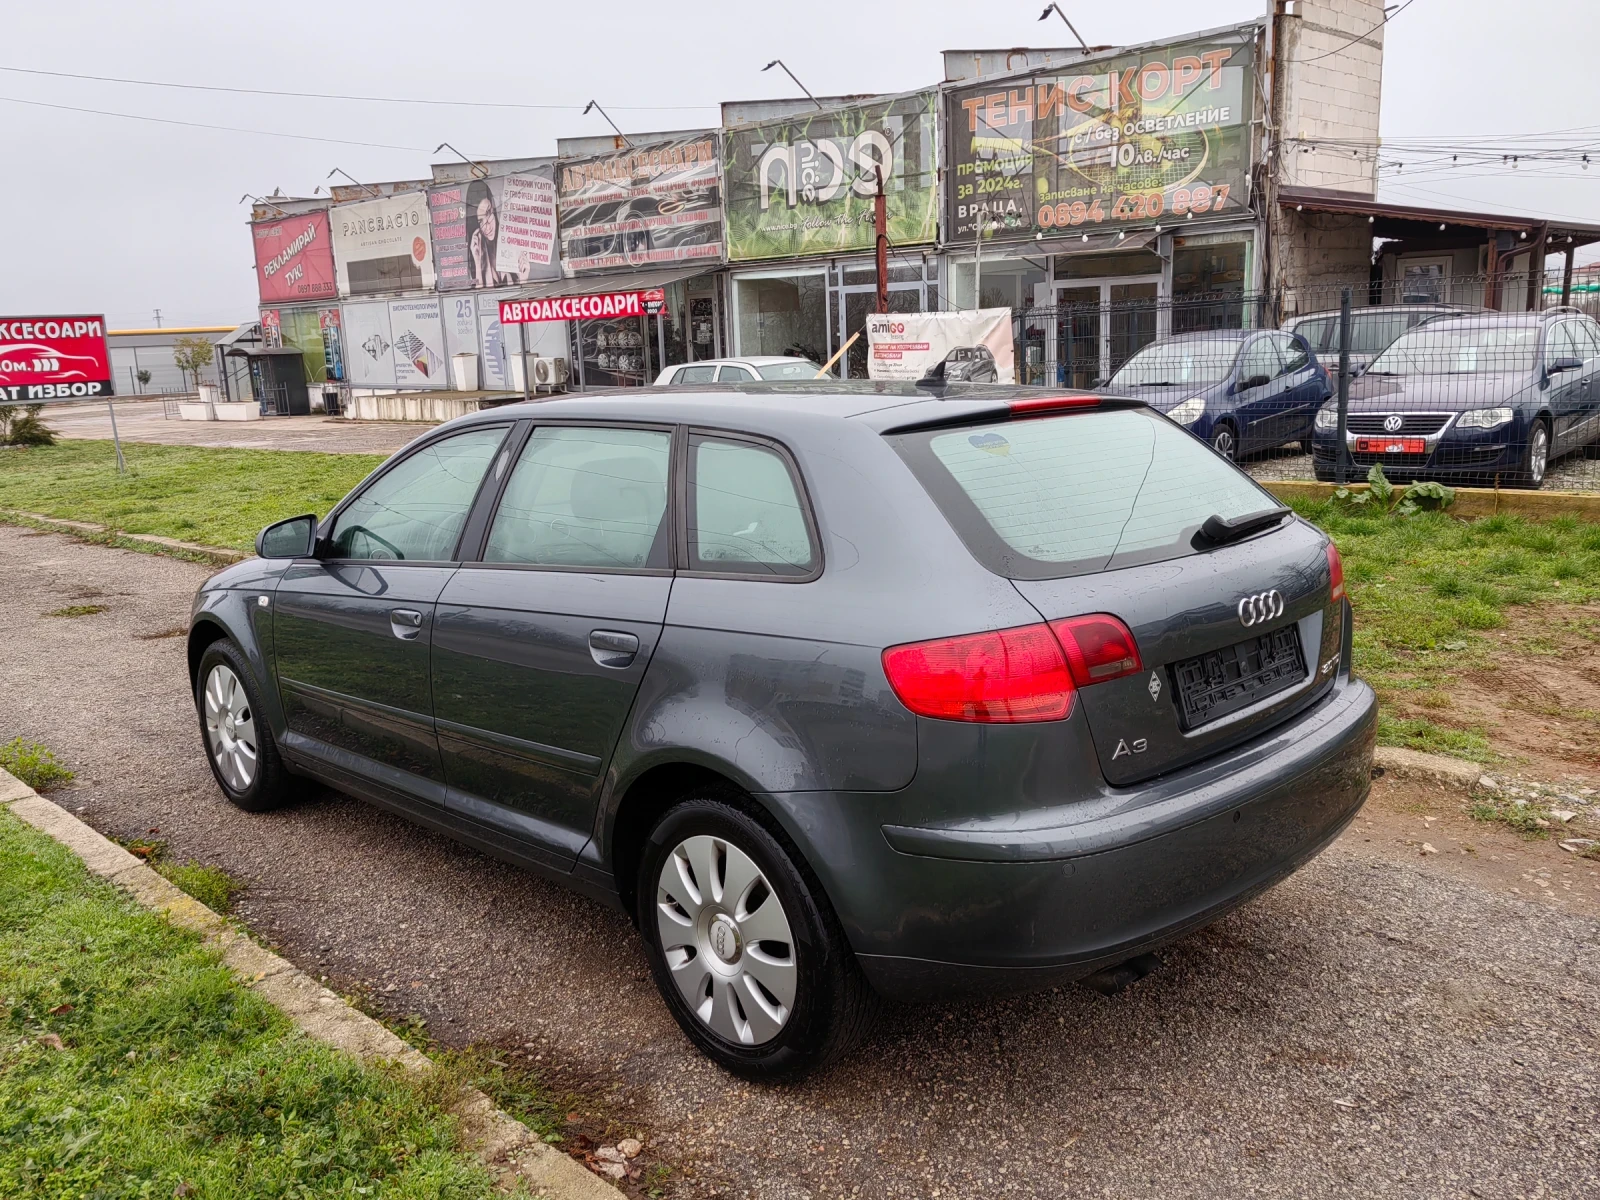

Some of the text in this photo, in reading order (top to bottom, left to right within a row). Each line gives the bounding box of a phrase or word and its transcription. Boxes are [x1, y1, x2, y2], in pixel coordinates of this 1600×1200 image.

[962, 48, 1232, 132] ТЕНИС КОРТ
[1123, 107, 1230, 135] ОСВЕТЛЕНИЕ
[561, 140, 713, 192] АВТОАКСЕСОАРИ
[977, 175, 1024, 194] 2024г.
[958, 199, 1023, 218] ВРАЦА,
[1037, 184, 1231, 228] 0894 420 887
[342, 211, 420, 236] PANCRACIO
[761, 222, 798, 233] www.nice.bg
[801, 216, 832, 231] Follow
[834, 212, 854, 225] the
[264, 222, 316, 279] РЕКЛАМИРАЙ
[285, 263, 303, 287] ТУК!
[455, 299, 472, 318] 25
[502, 293, 639, 322] АВТОАКСЕСОАРИ
[28, 382, 102, 398] ИЗБОР
[1112, 738, 1148, 761] A3
